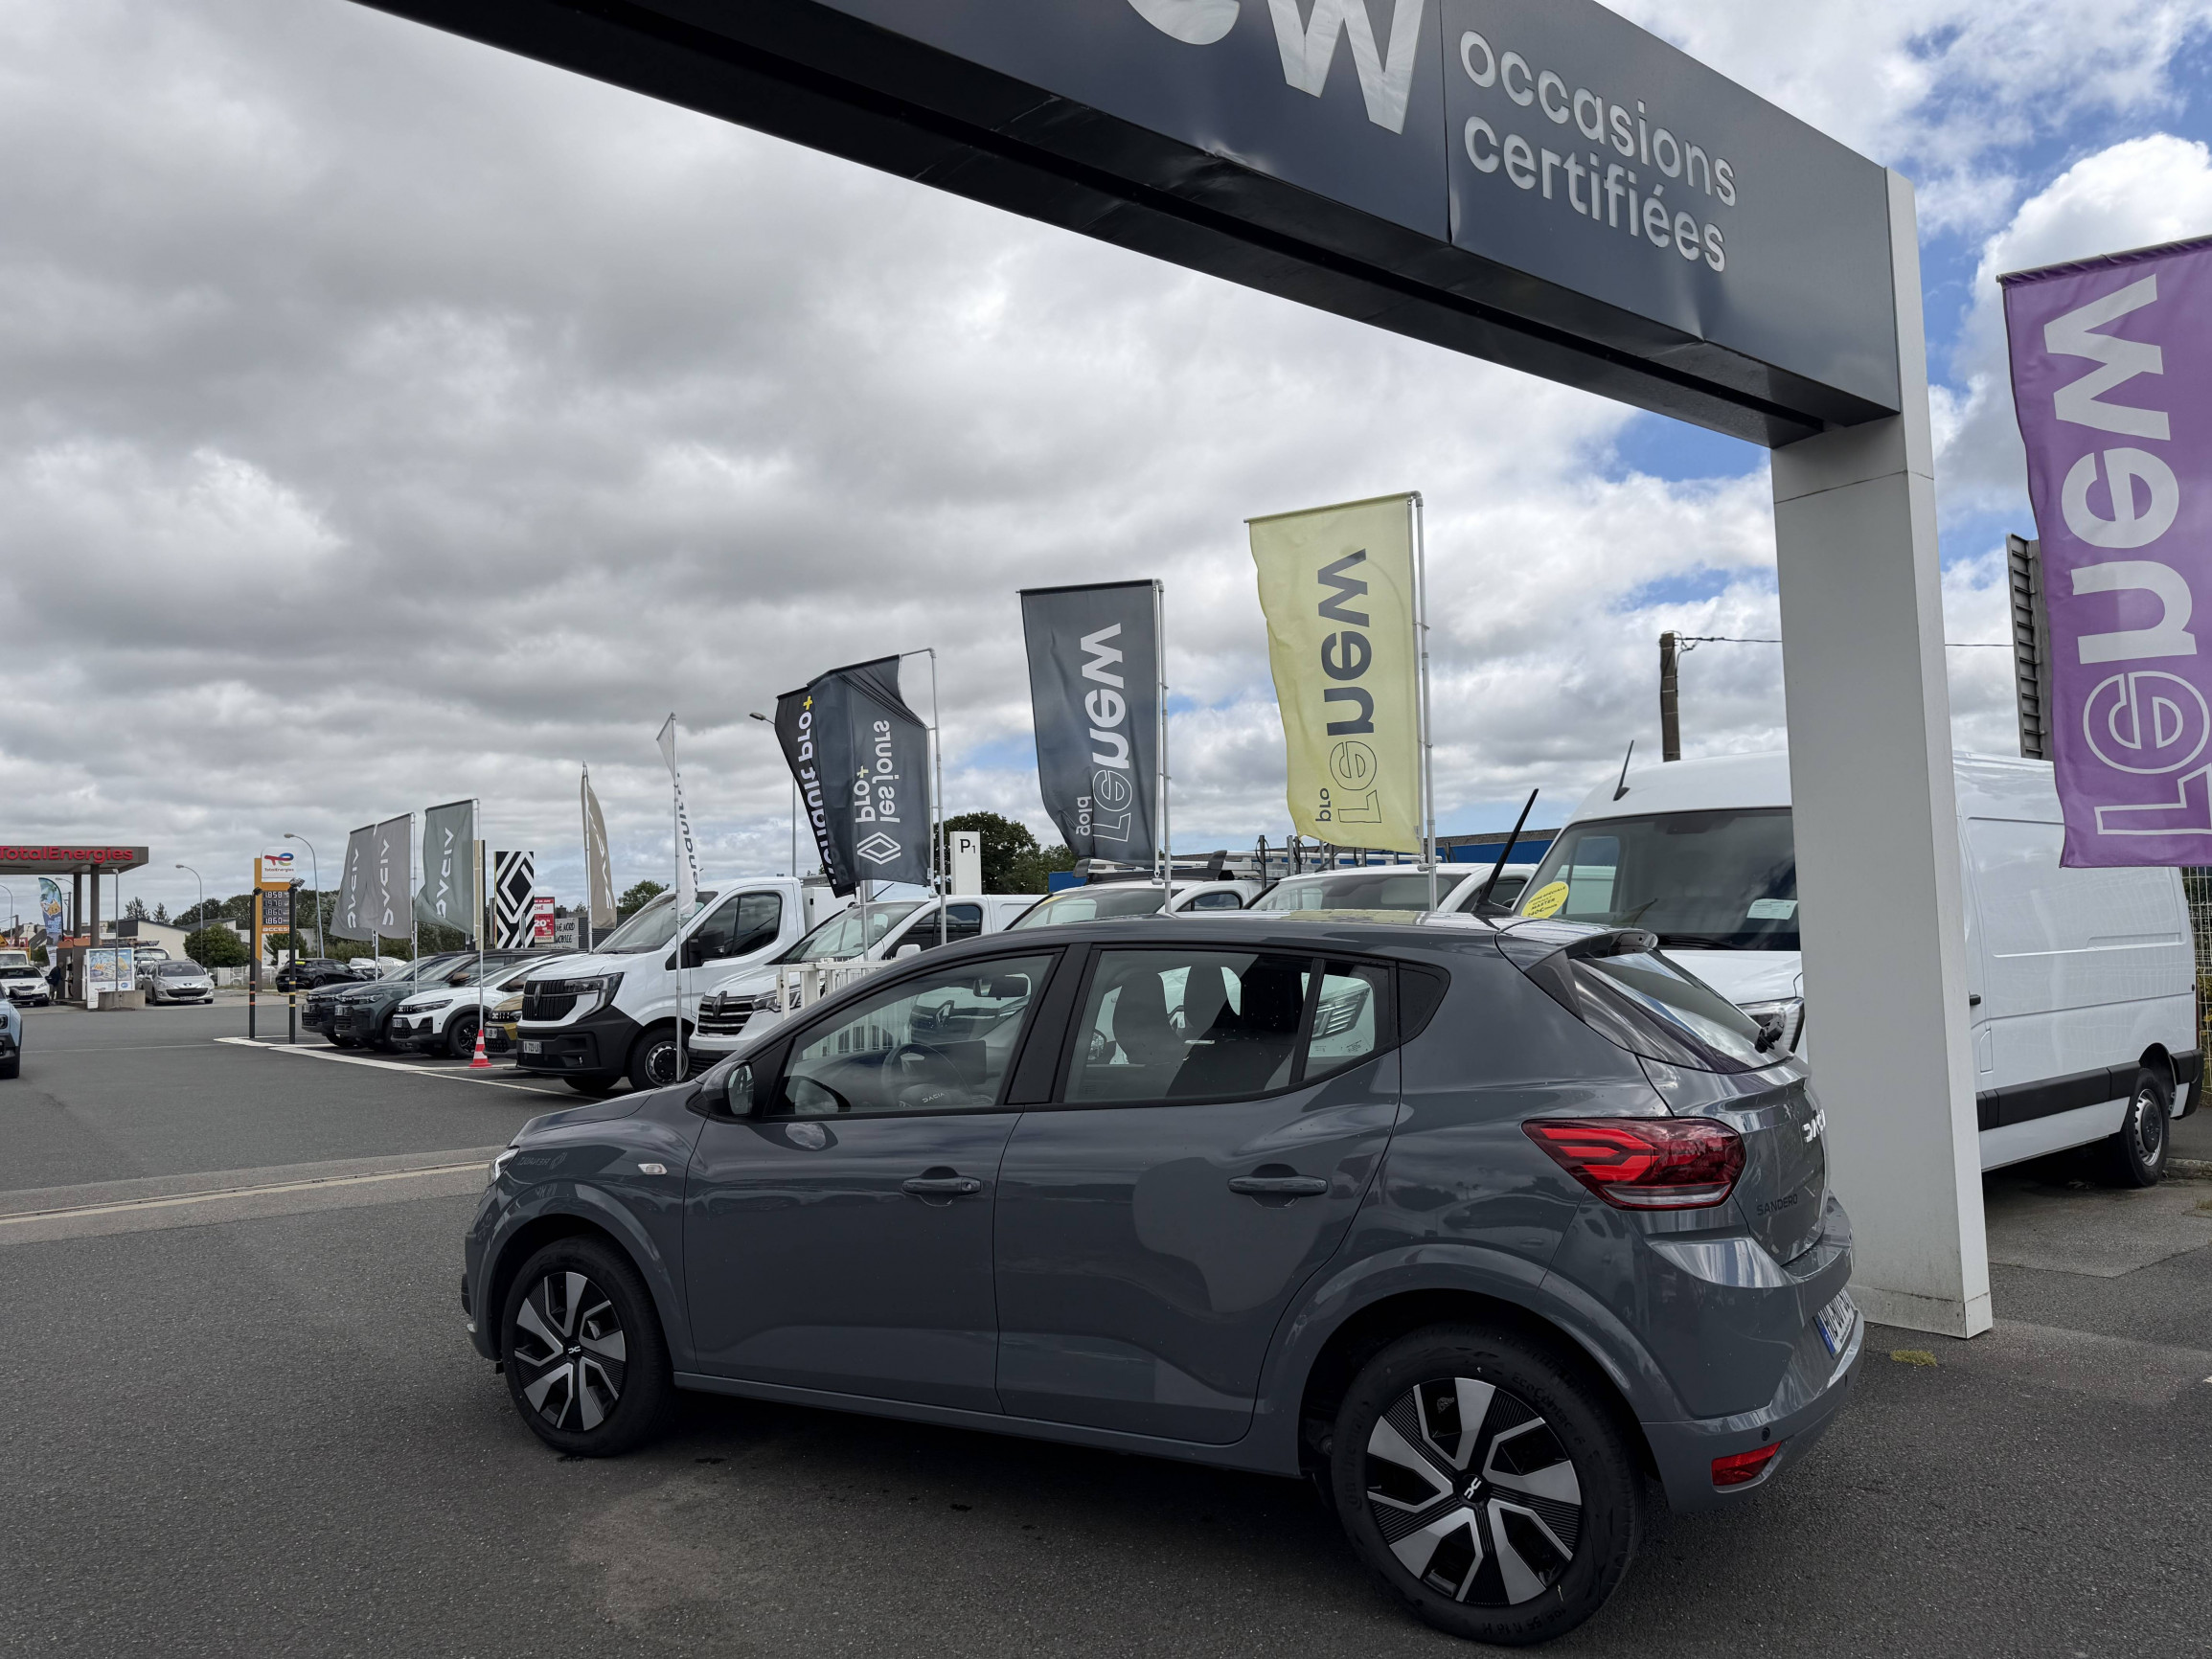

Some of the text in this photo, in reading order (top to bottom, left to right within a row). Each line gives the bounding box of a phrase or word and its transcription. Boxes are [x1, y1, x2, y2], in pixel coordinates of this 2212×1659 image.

[1460, 31, 1737, 207] occasions
[1464, 116, 1725, 272] certifiées
[0, 846, 134, 863] TotalEnergies
[1756, 1193, 1798, 1216] SANDERO
